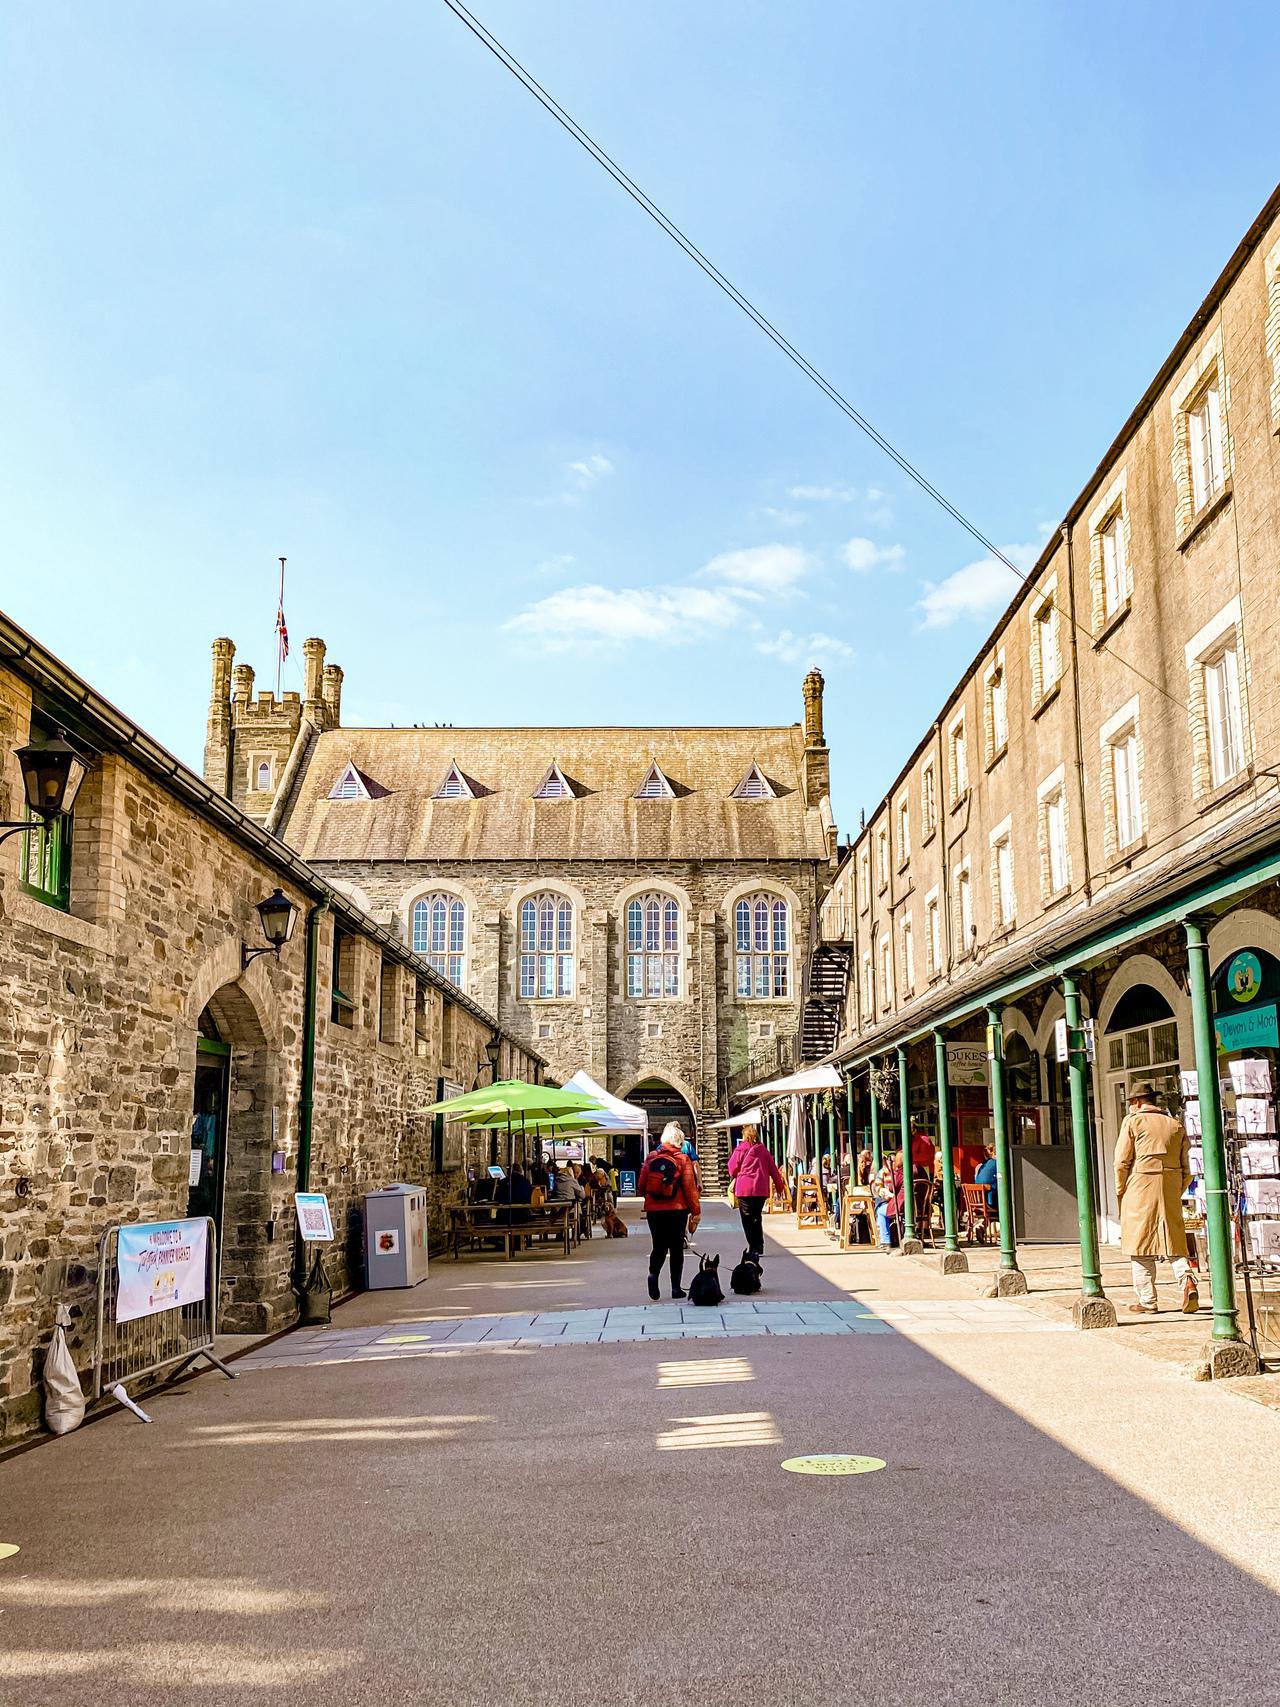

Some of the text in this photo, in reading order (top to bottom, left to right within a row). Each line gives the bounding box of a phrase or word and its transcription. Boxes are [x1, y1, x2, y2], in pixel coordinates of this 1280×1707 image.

[1223, 1022, 1246, 1037] Devon
[1248, 1016, 1255, 1032] &
[947, 1051, 988, 1062] DUKES
[153, 1230, 173, 1245] WELCOME
[159, 1248, 175, 1265] PANNIER
[176, 1246, 191, 1262] MARKET
